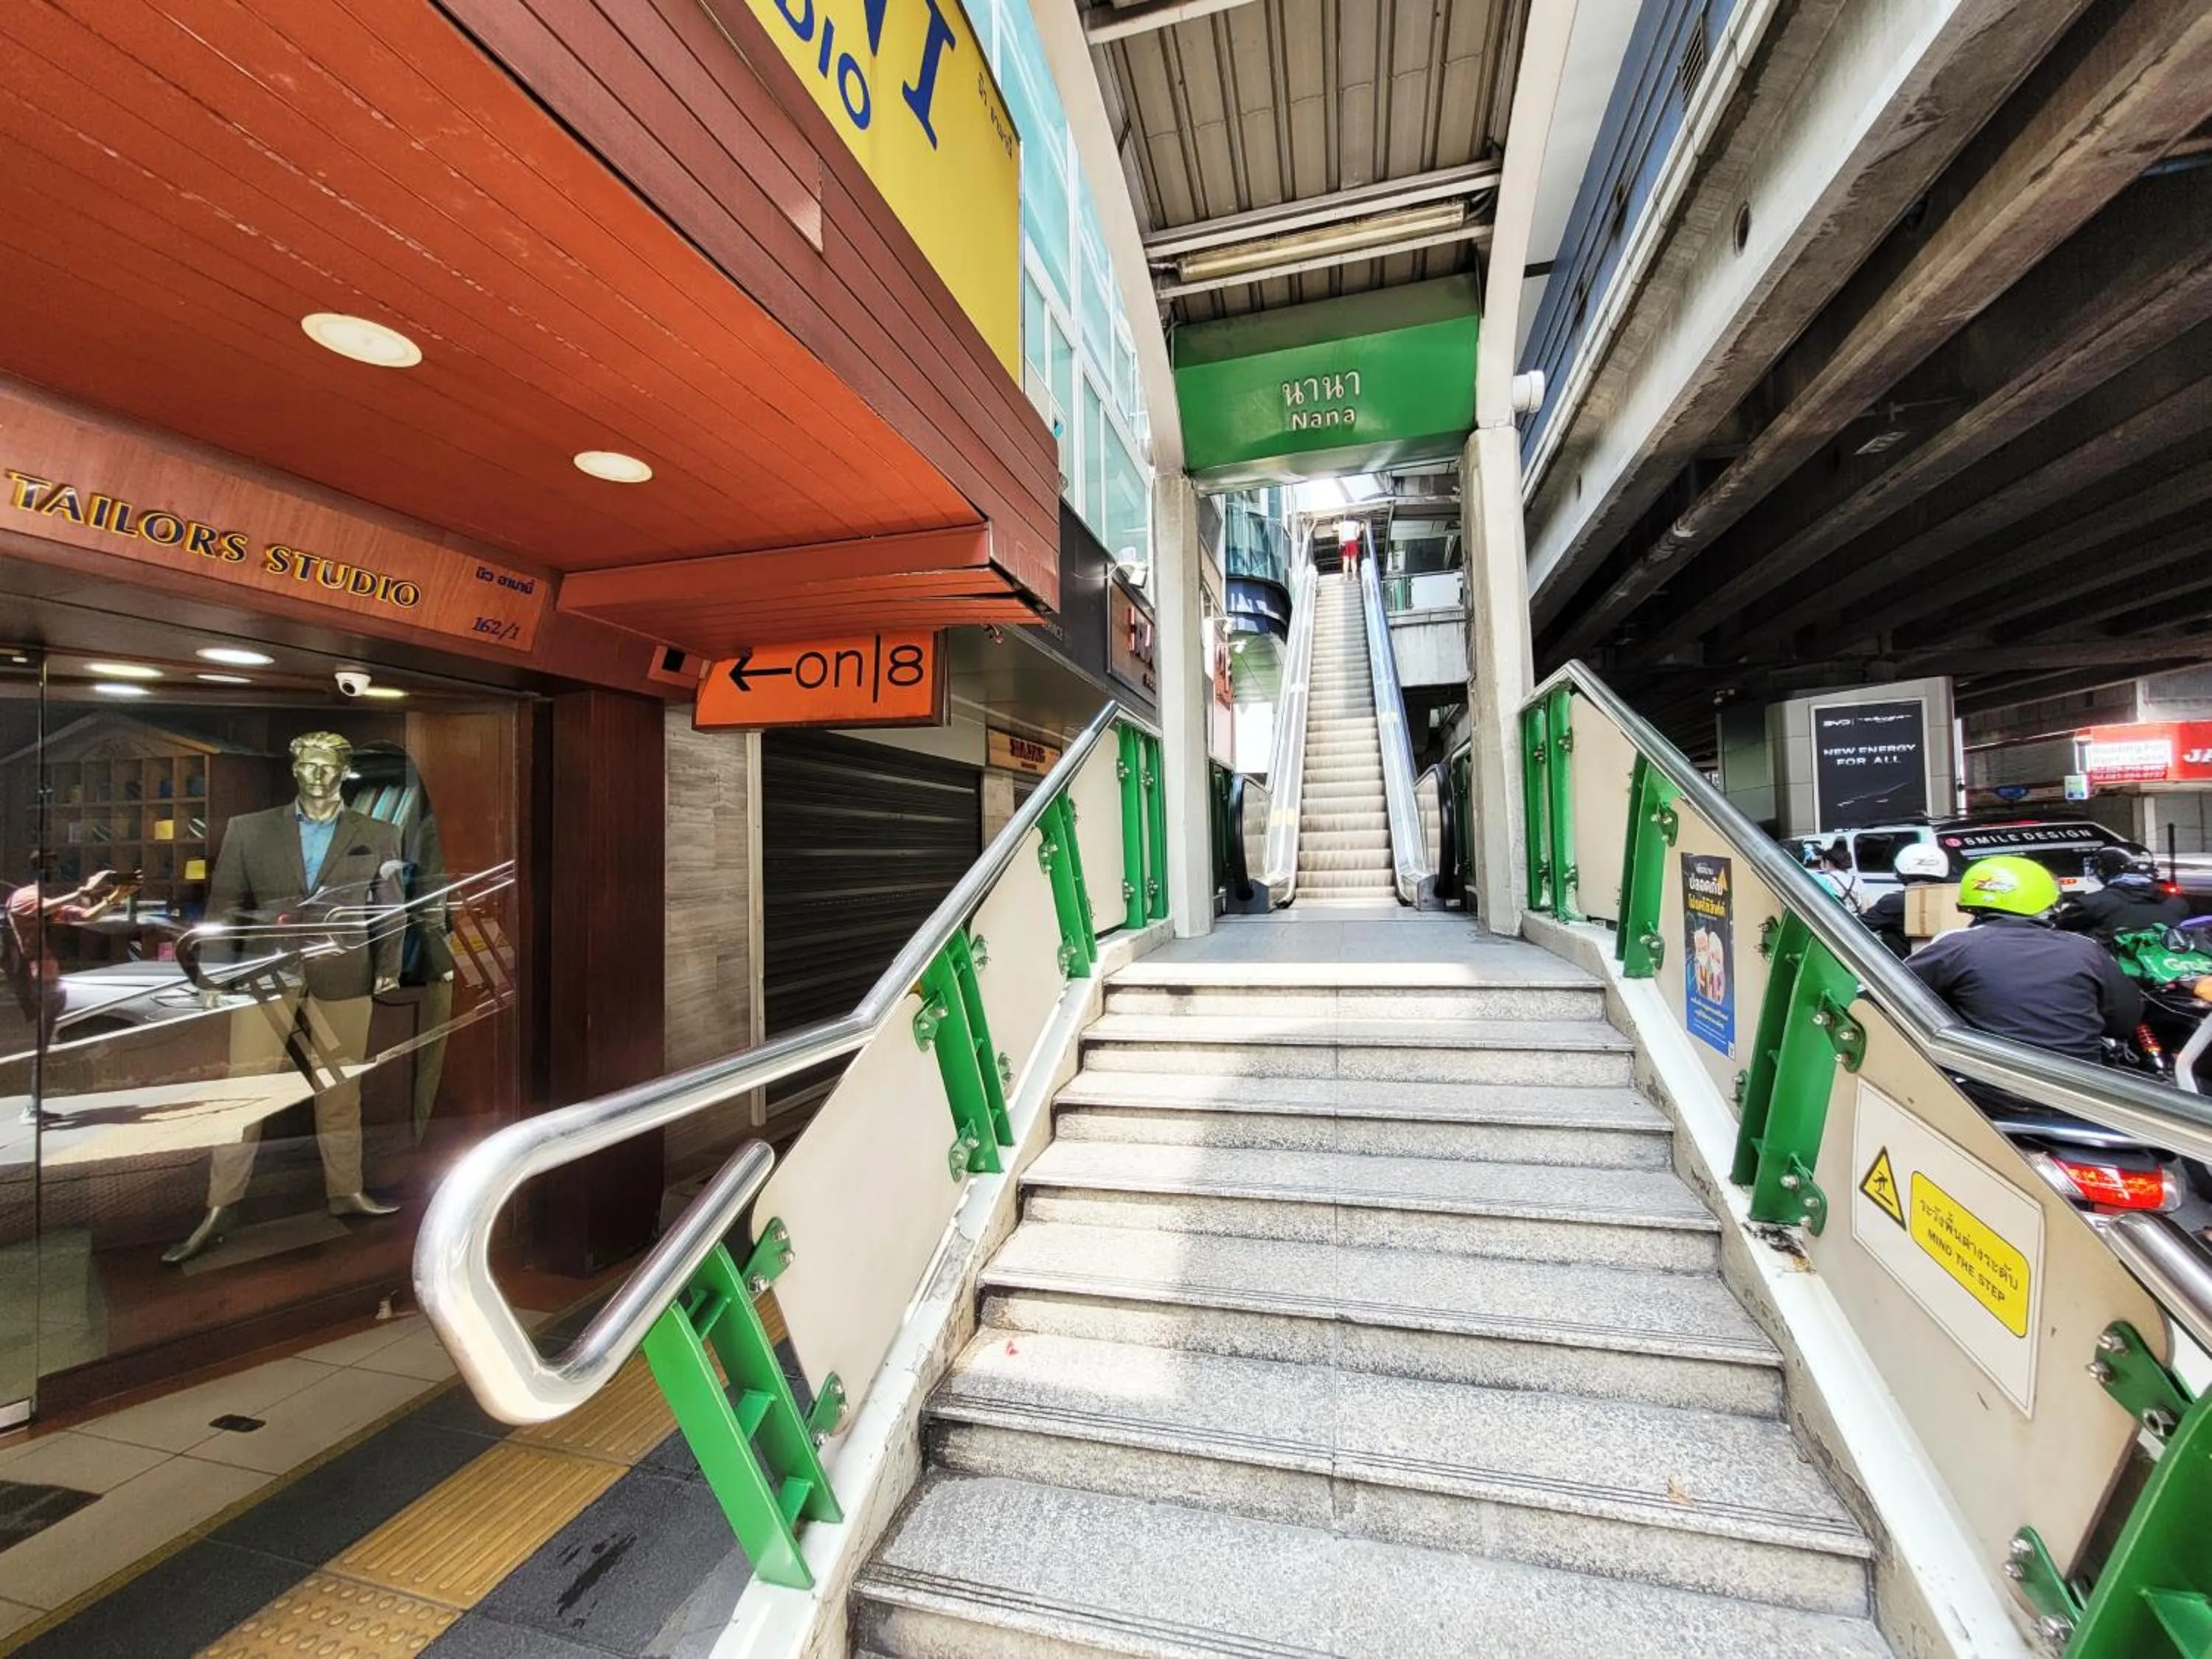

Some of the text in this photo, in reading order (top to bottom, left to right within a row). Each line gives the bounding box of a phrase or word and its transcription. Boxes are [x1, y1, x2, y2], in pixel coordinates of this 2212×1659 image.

[1281, 370, 1361, 406] นานา
[1292, 407, 1356, 431] Nana
[6, 470, 422, 608] TAILORS STUDIO
[471, 616, 520, 641] 162/1
[1823, 743, 1916, 756] NEW ENERGY
[1837, 755, 1902, 766] FOR ALL
[1964, 829, 2093, 846] SMILE DESIGN
[1920, 1200, 2018, 1290] ระวังพื้นต่างระดับ
[1927, 1228, 2006, 1301] MIND THE STEP
